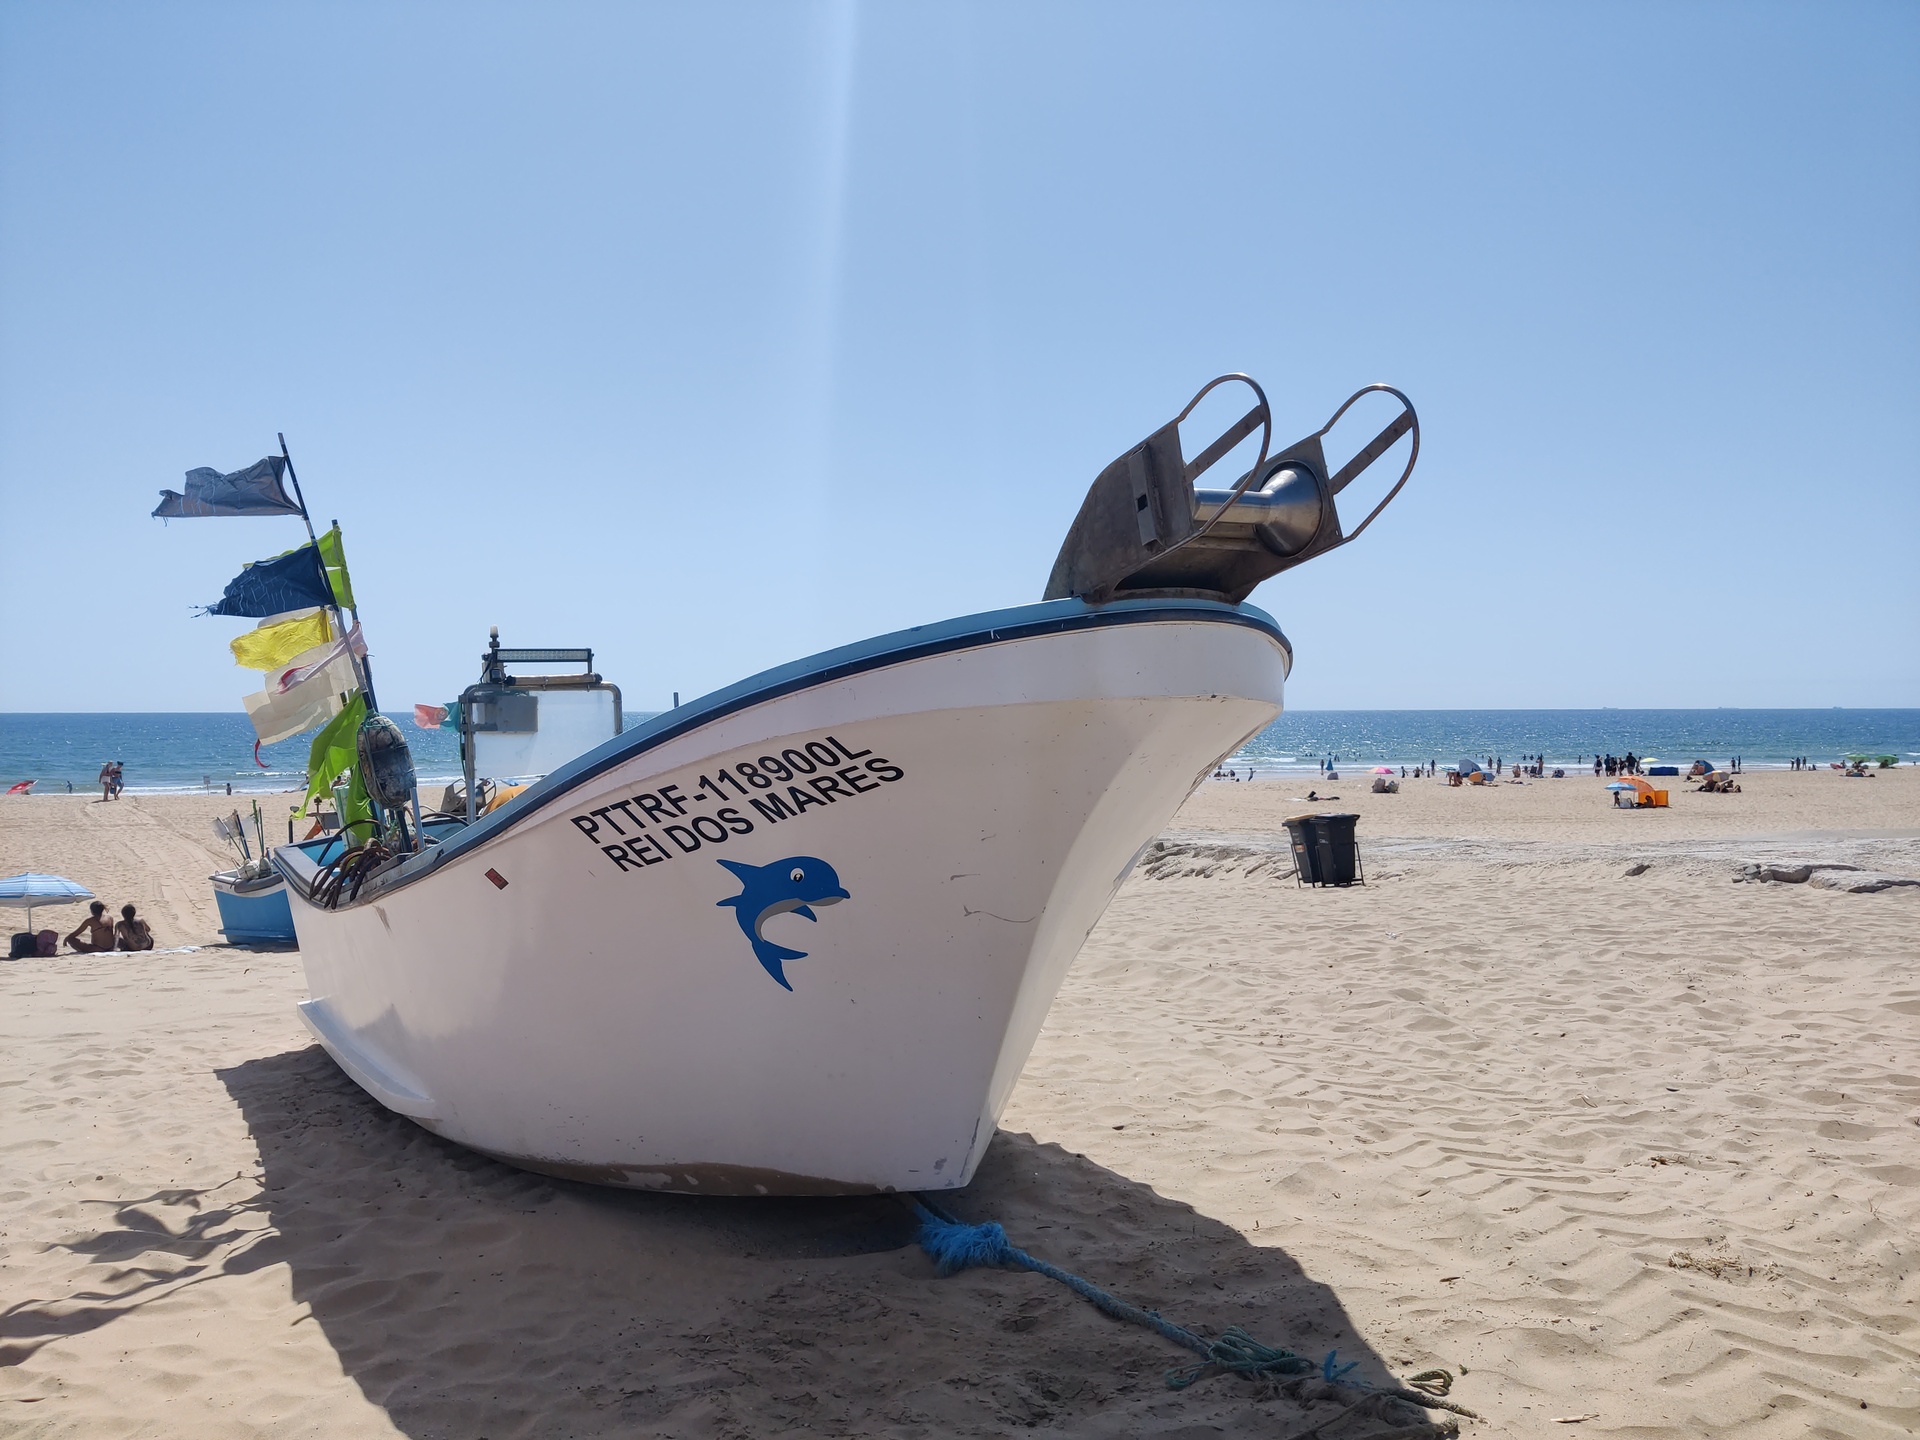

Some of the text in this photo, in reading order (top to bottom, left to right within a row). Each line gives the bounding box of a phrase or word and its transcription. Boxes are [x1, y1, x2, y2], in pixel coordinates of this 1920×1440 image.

[570, 736, 873, 844] PTTRF-118900L
[601, 757, 905, 872] REI DOS MARES
